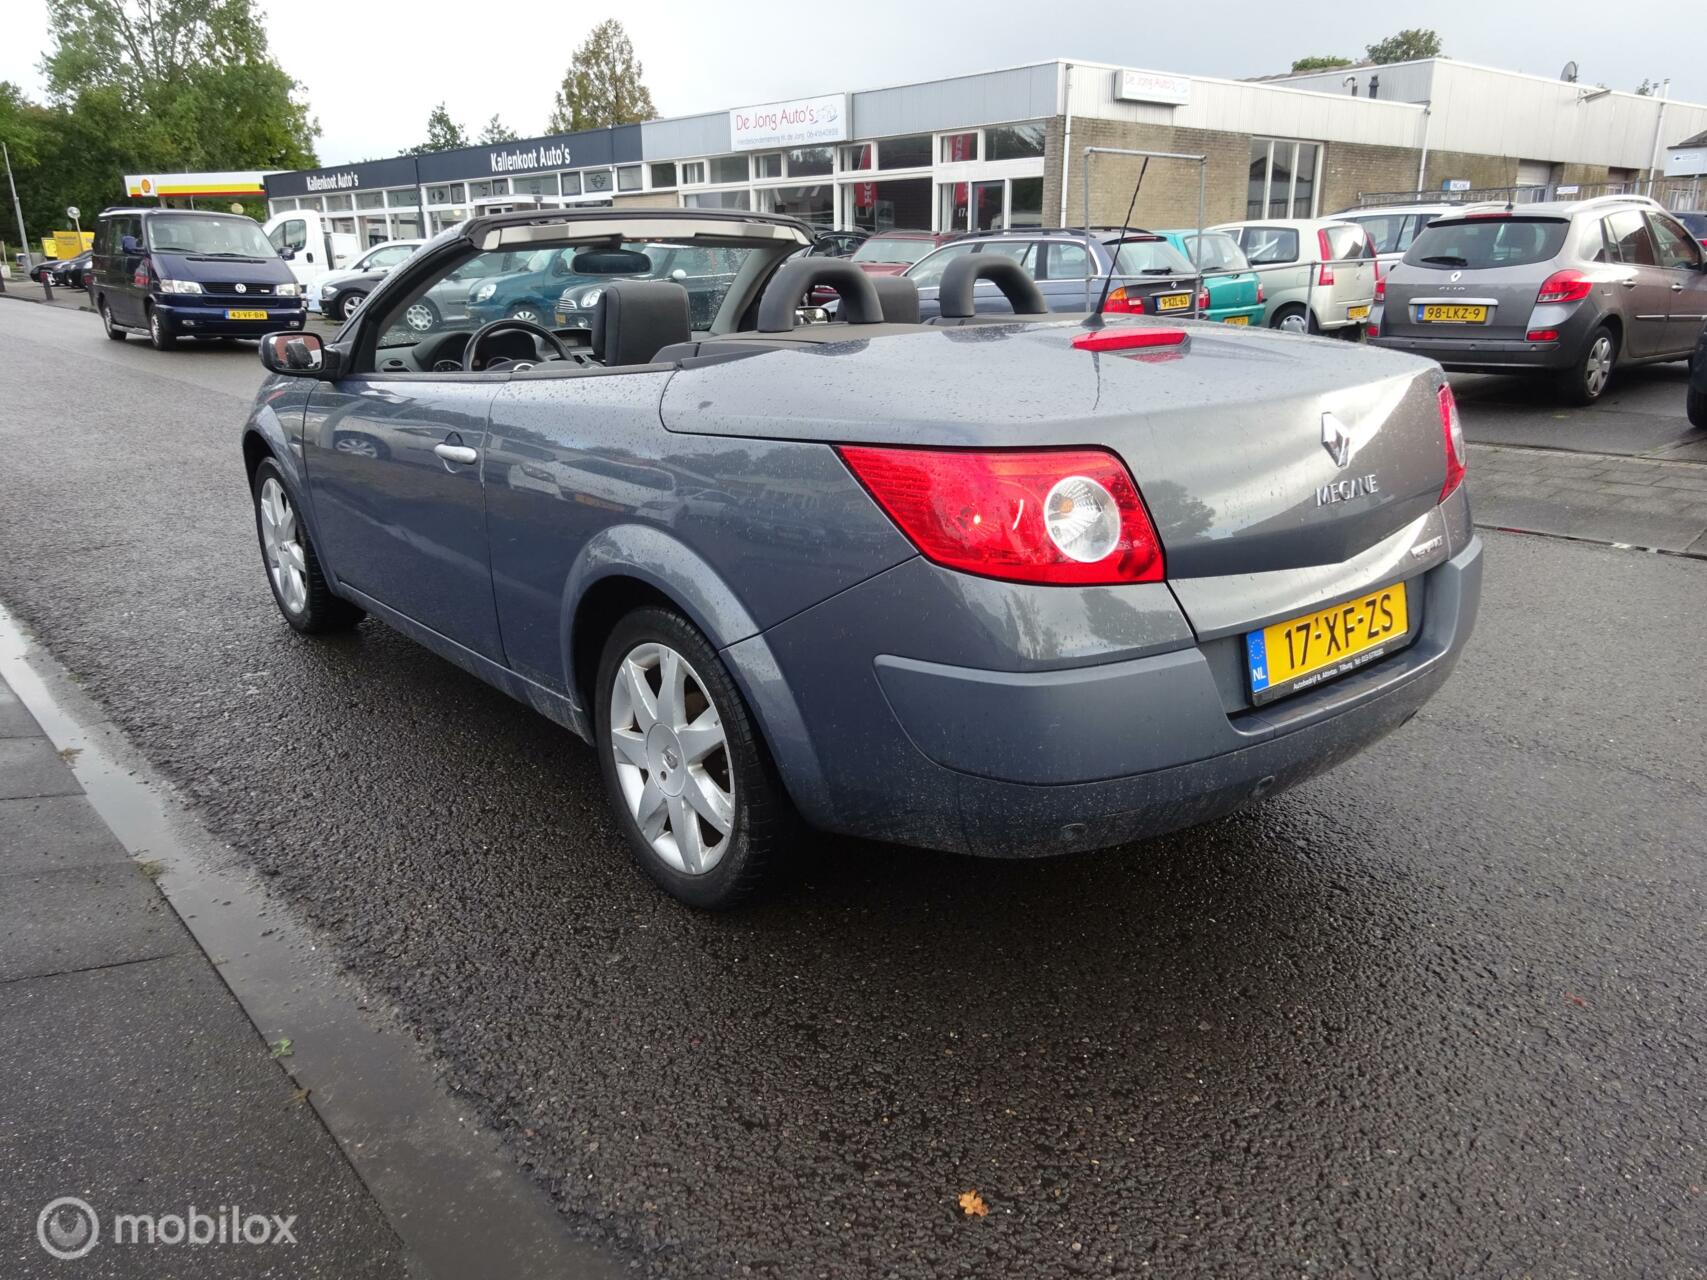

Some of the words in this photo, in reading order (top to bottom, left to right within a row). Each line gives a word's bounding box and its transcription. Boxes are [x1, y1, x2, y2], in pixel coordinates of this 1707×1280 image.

[736, 115, 750, 130] De
[752, 112, 777, 131] Jong
[780, 105, 815, 125] Auto's
[490, 149, 538, 172] Kallenkoot
[540, 143, 571, 167] Auto's
[306, 173, 338, 191] Kallenkoot
[338, 171, 359, 188] Auto's
[1427, 307, 1481, 319] 98-LKZ-9
[1315, 474, 1379, 507] MEGANE
[1284, 593, 1393, 670] 17-XF-ZS
[1252, 666, 1267, 682] NL
